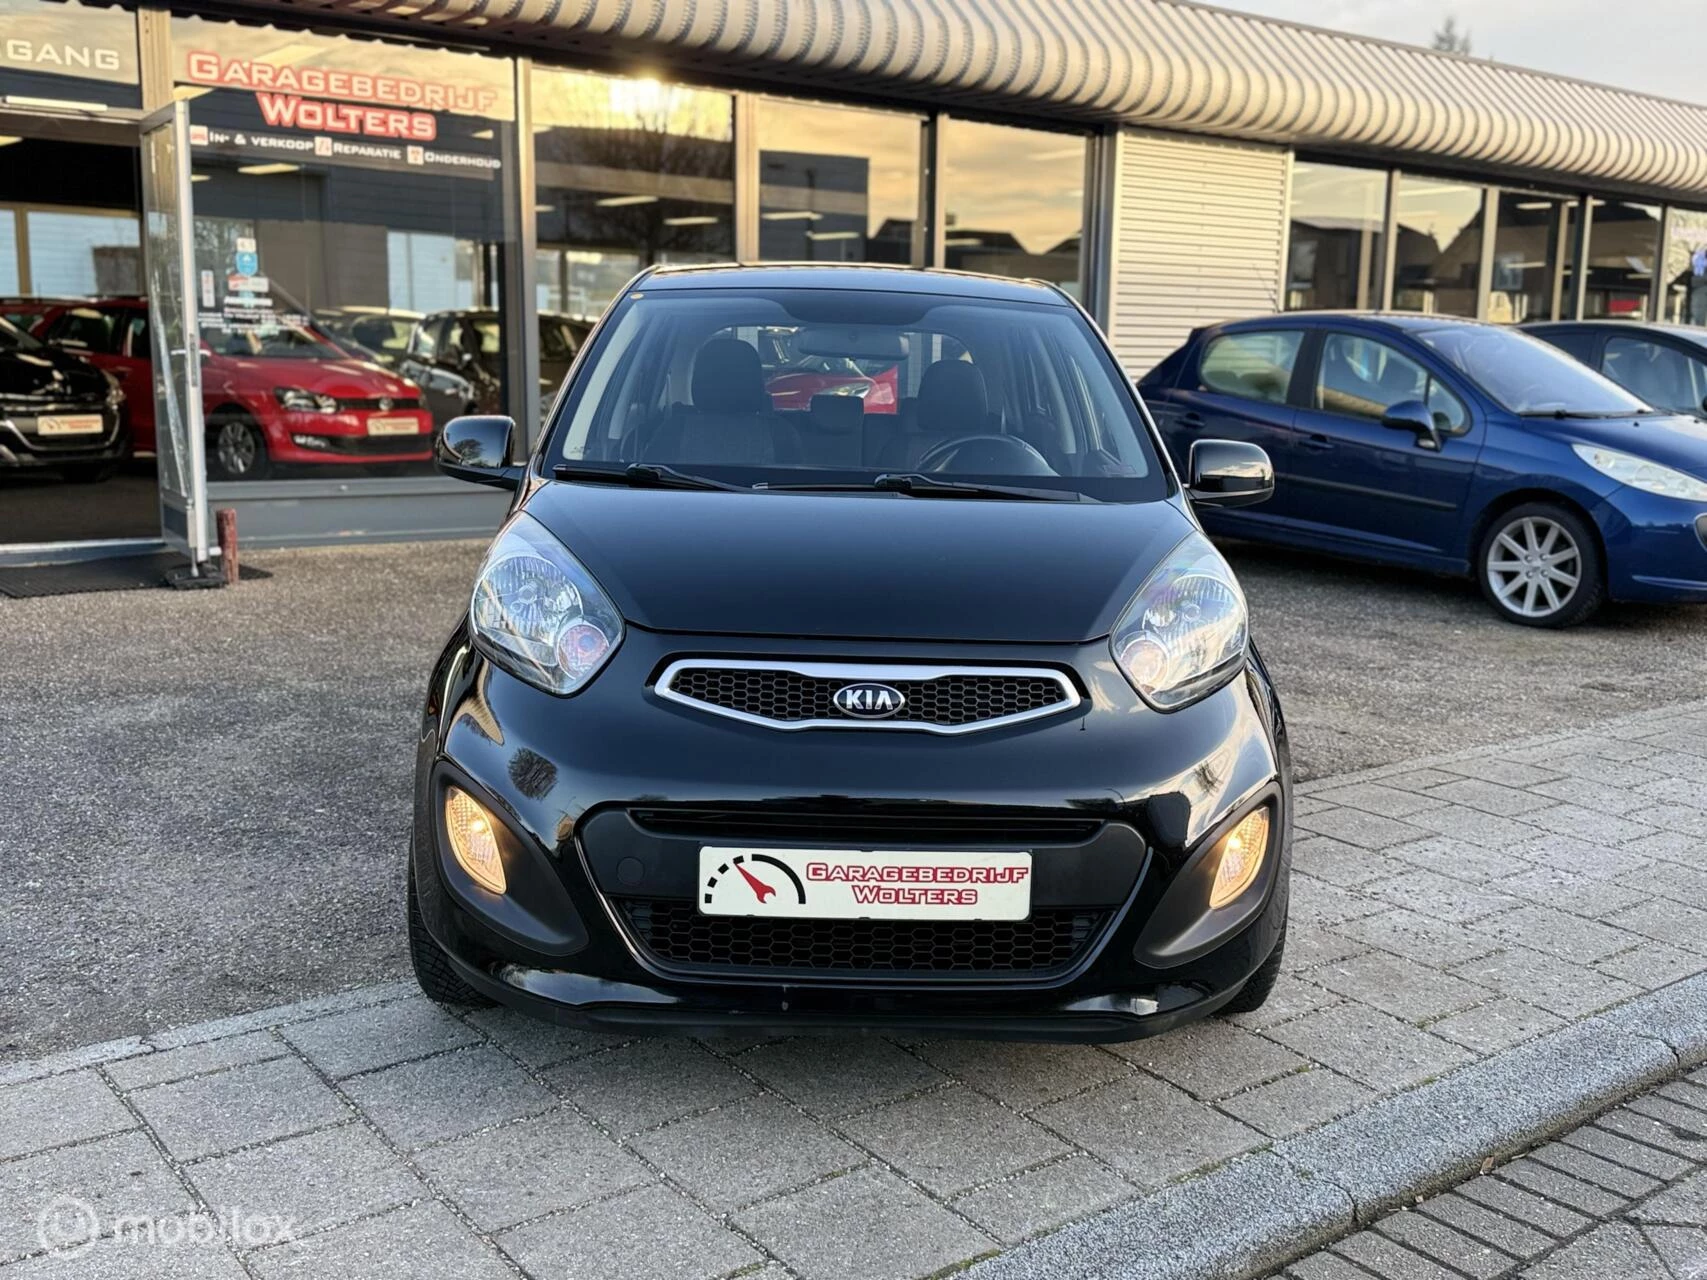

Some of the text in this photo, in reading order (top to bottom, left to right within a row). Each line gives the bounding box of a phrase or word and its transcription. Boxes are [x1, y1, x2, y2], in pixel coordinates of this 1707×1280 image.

[188, 51, 498, 113] GARAGEBEDRIJF
[256, 92, 437, 141] WOLTERS
[234, 133, 247, 145] &
[251, 136, 314, 151] VERKOOP
[333, 142, 402, 160] REPARATIE
[425, 151, 502, 169] ONDERHOUD
[845, 689, 894, 710] KIA
[806, 862, 1029, 883] GARAGEBEDRIJF
[852, 884, 978, 905] WOLTERS
